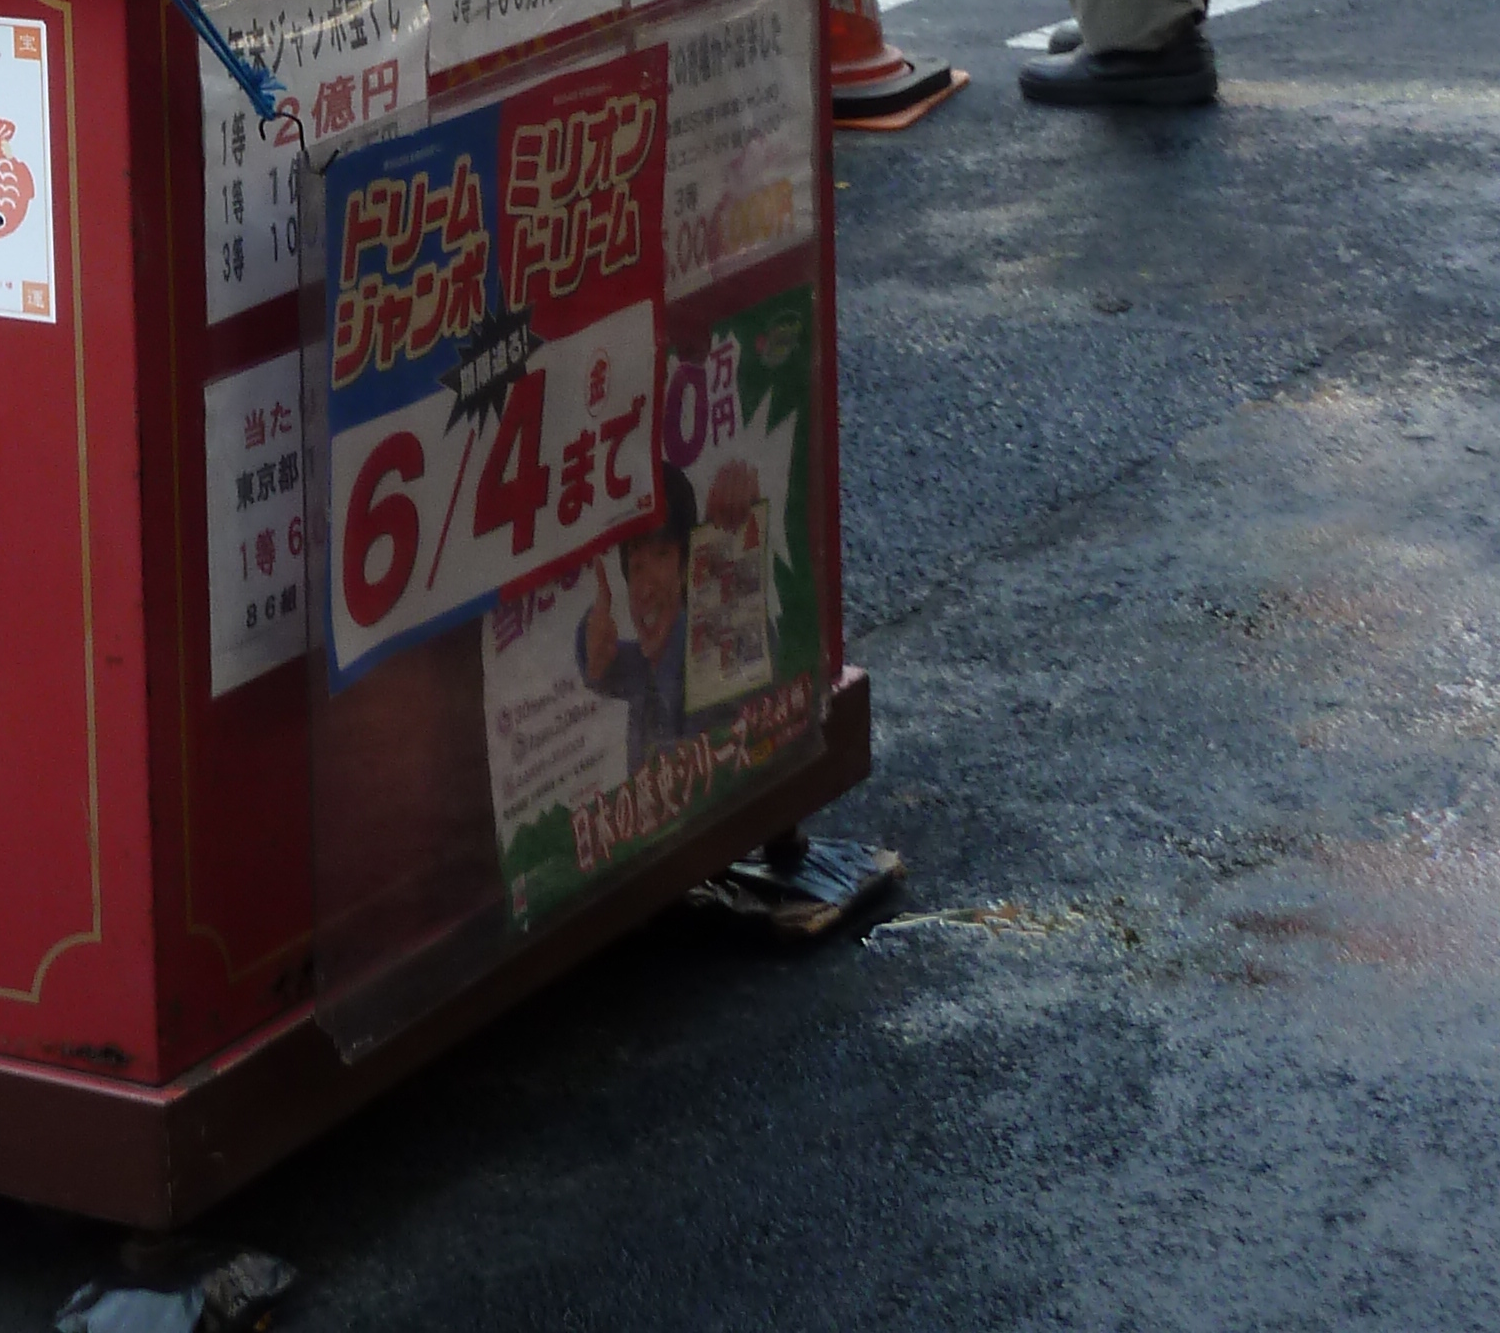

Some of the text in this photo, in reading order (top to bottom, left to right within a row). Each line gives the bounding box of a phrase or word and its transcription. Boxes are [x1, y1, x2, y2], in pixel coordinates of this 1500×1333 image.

[272, 58, 399, 148] 2億円
[507, 94, 656, 217] ミリオン
[338, 153, 484, 293] ドリーム
[504, 183, 641, 315] ドリーム
[330, 233, 491, 390] ジャンボ
[342, 367, 549, 630] 6/4
[557, 394, 647, 527] まで
